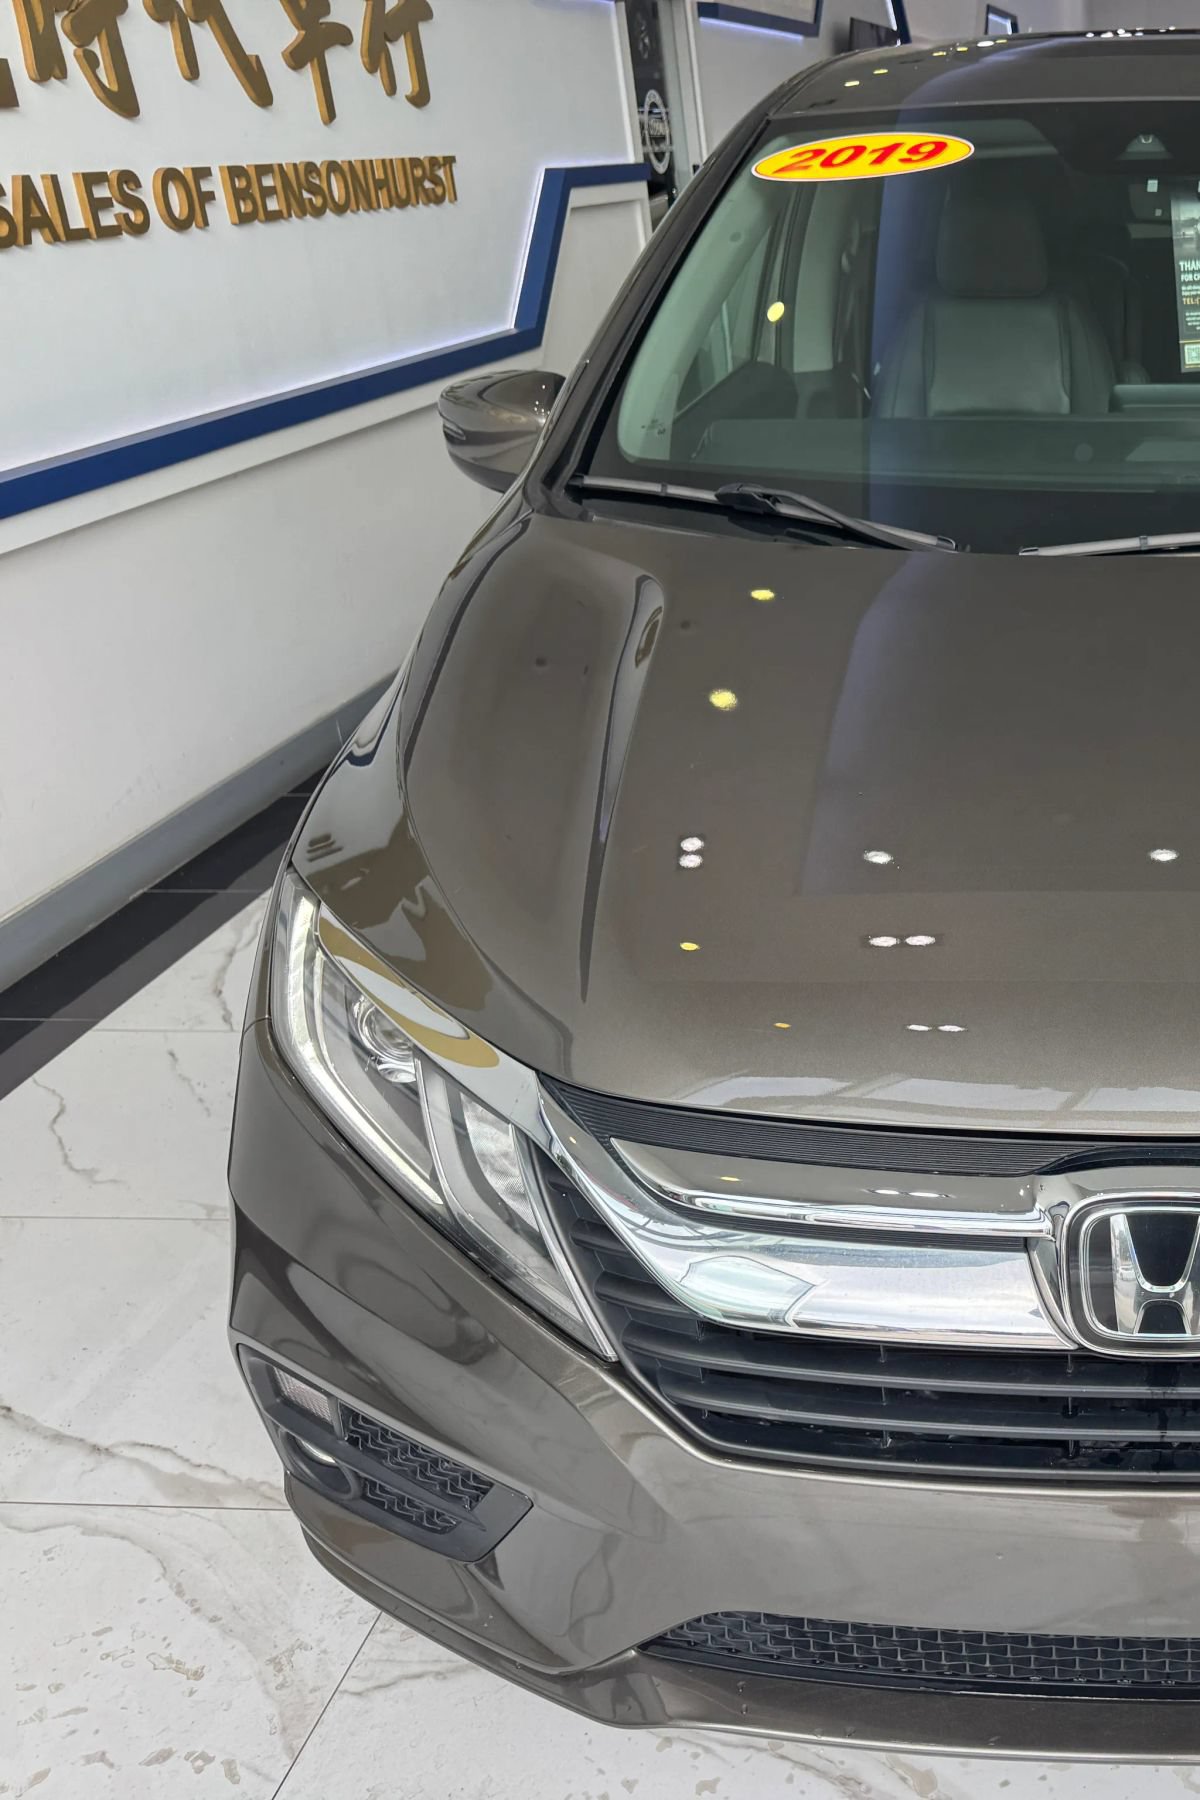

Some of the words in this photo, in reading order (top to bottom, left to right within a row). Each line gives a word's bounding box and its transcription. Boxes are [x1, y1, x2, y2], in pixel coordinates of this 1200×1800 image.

[771, 140, 949, 175] 2019
[0, 169, 151, 248] SALES
[153, 166, 216, 231] OF
[218, 155, 458, 226] BENSONHURST
[1181, 273, 1193, 281] FOR
